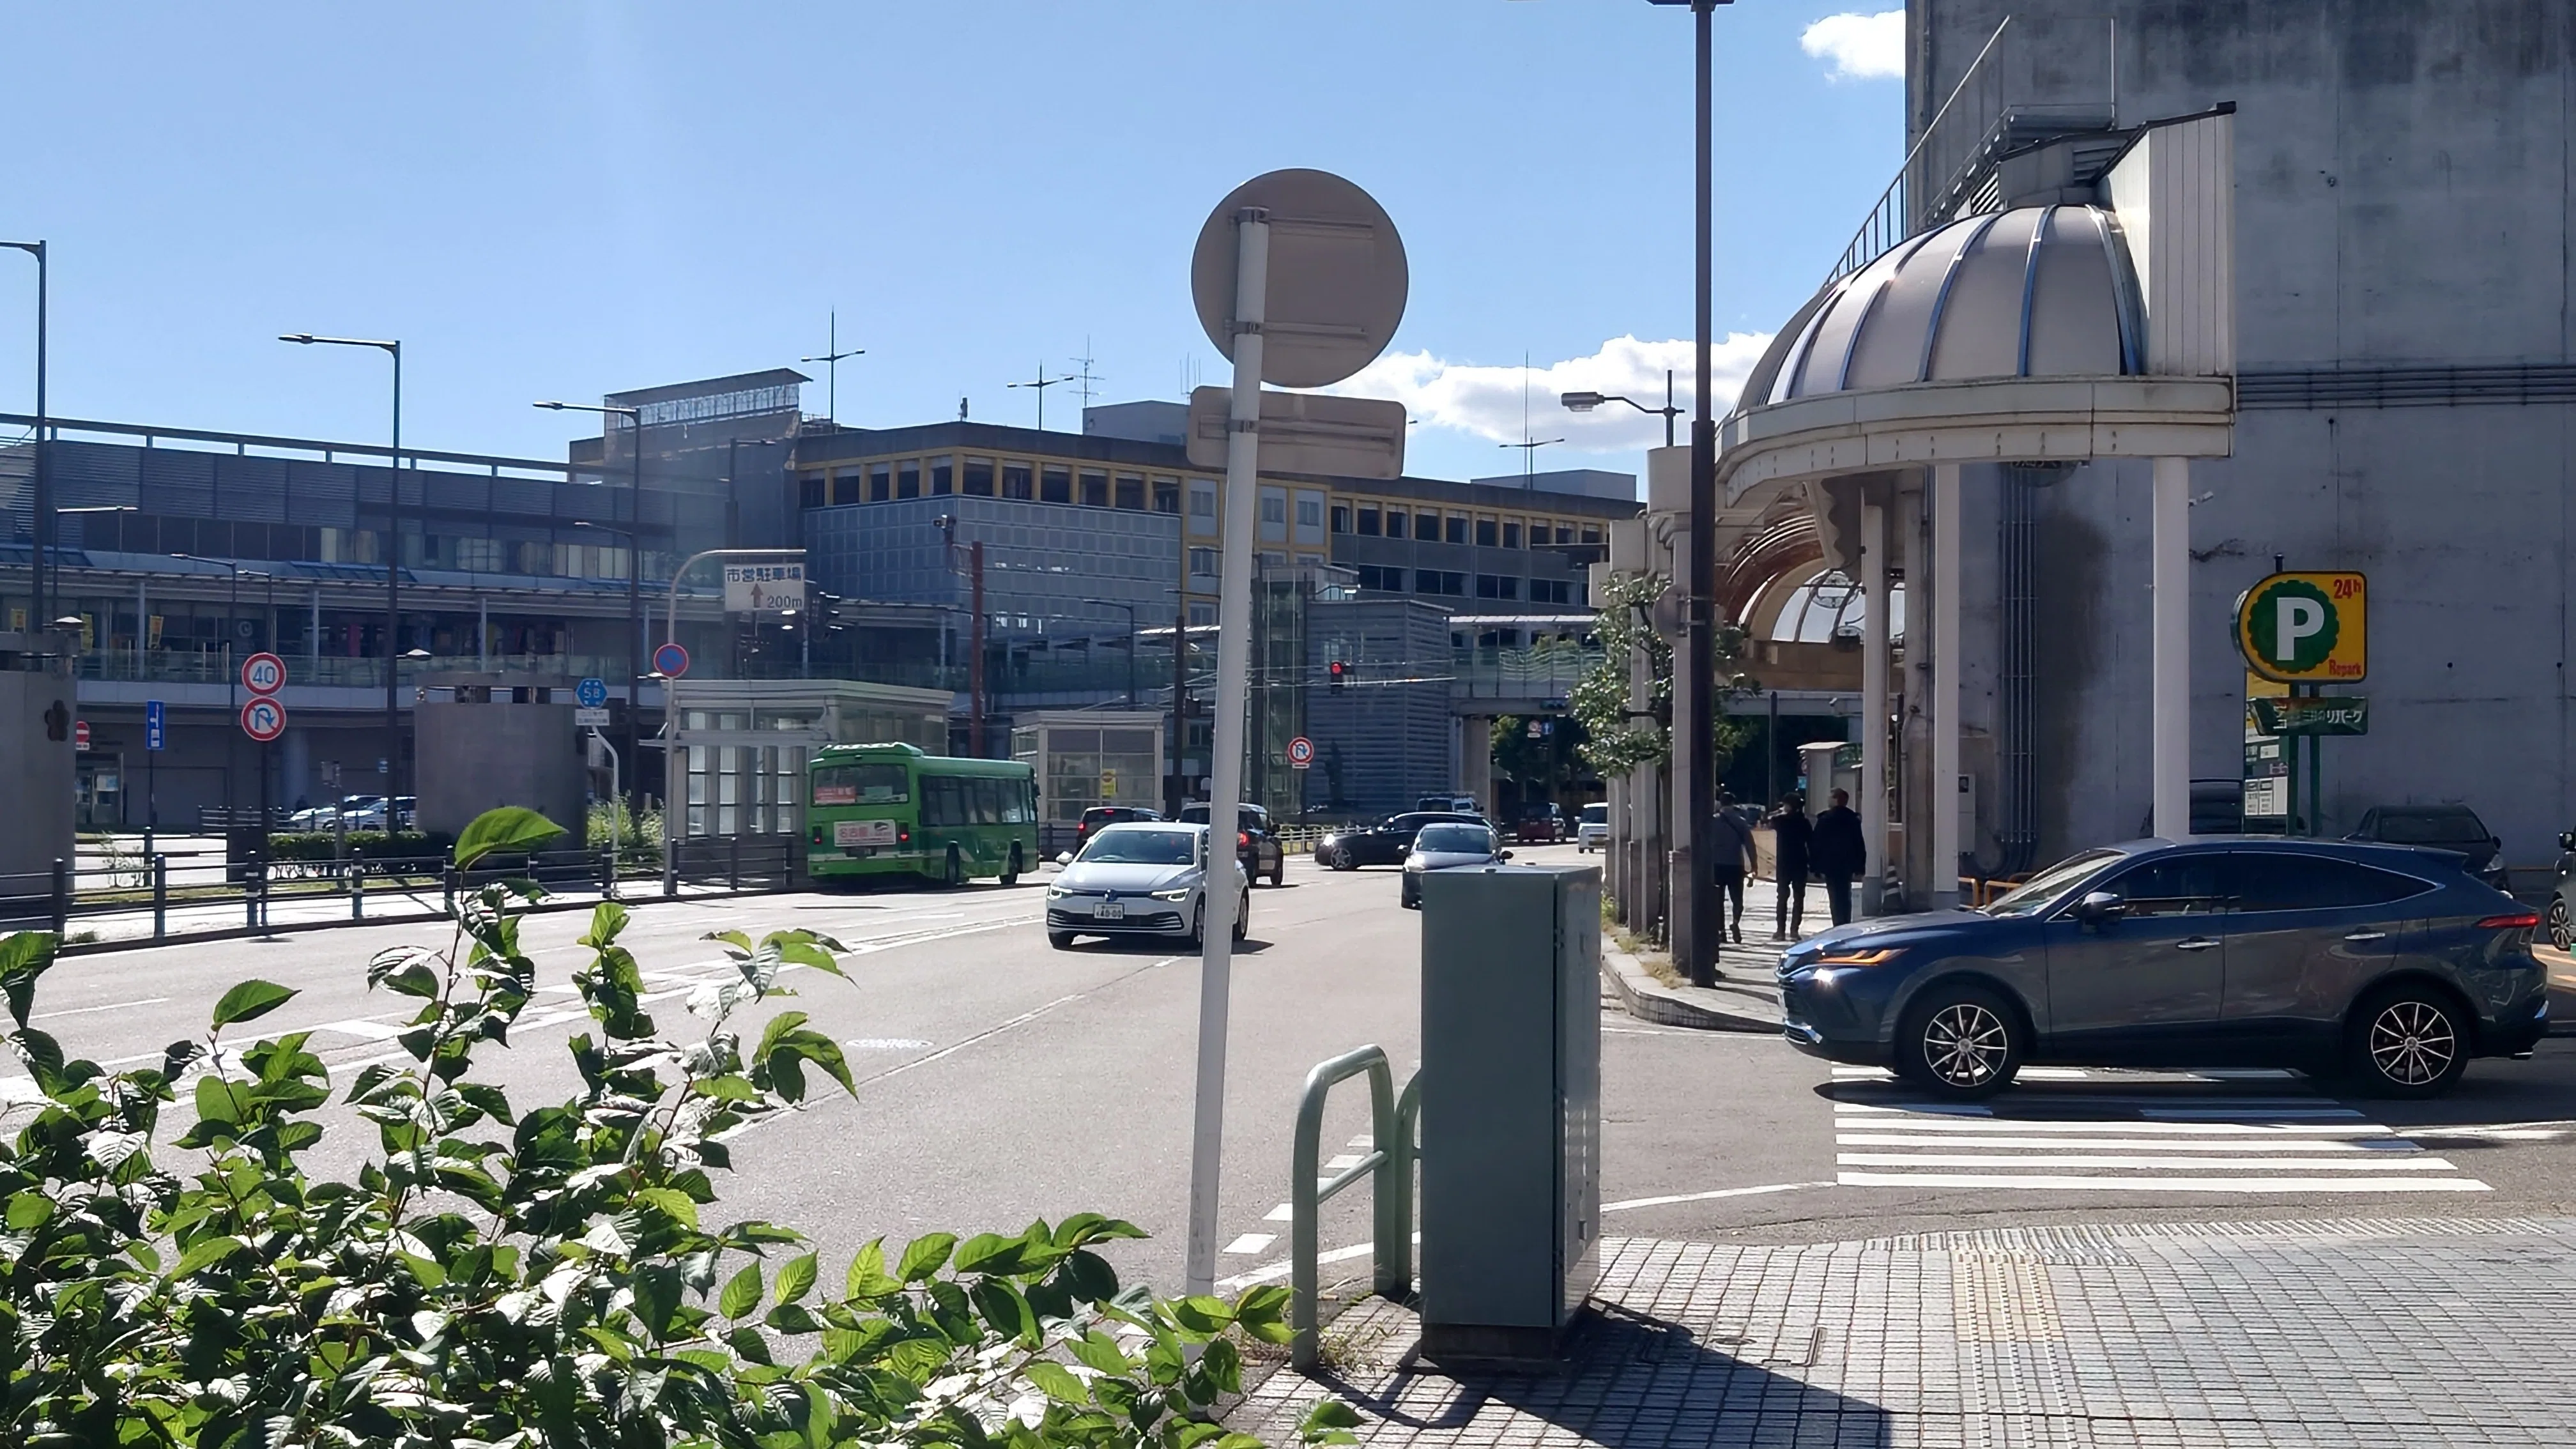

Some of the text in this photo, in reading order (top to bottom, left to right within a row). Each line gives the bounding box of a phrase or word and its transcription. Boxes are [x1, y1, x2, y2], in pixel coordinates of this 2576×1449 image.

[726, 567, 802, 582] 市営駐車場
[2334, 579, 2362, 599] 24h
[767, 595, 802, 608] 200m
[2276, 597, 2324, 661] P
[252, 666, 275, 684] 40
[2328, 659, 2362, 677] Repark
[584, 687, 601, 698] 58
